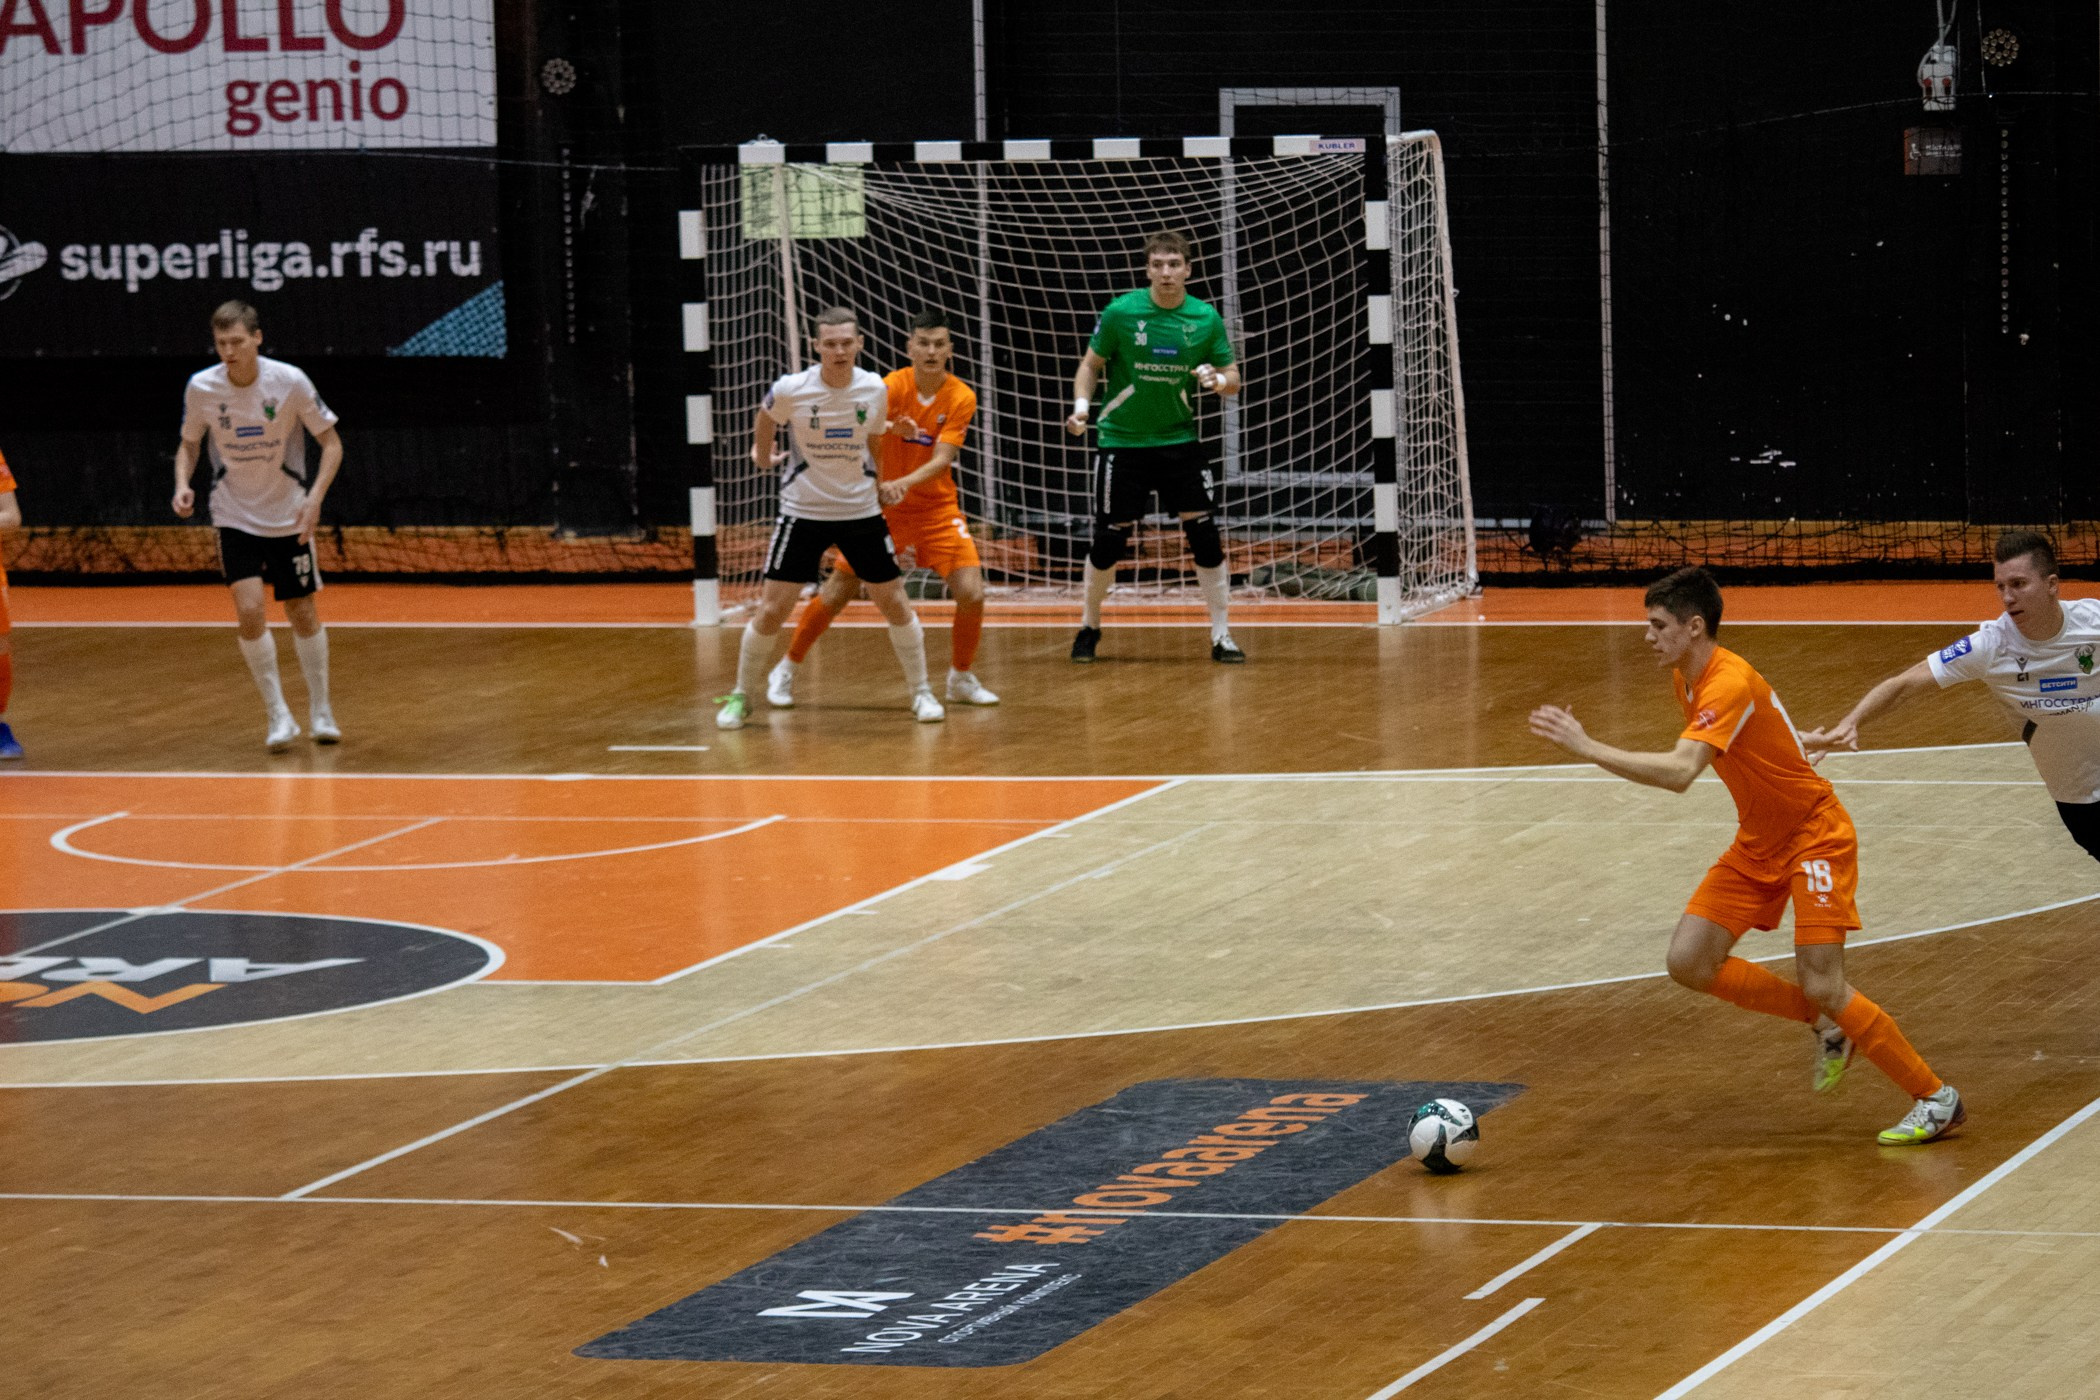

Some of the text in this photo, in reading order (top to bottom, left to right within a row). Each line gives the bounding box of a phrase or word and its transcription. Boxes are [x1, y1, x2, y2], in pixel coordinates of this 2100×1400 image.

[225, 60, 410, 137] genio
[60, 228, 482, 293] superliga.rfs.ru
[1134, 332, 1148, 346] 30
[1801, 859, 1834, 893] 18
[974, 1092, 1370, 1245] #novaarena
[840, 1263, 1061, 1353] NOVA ARENA
